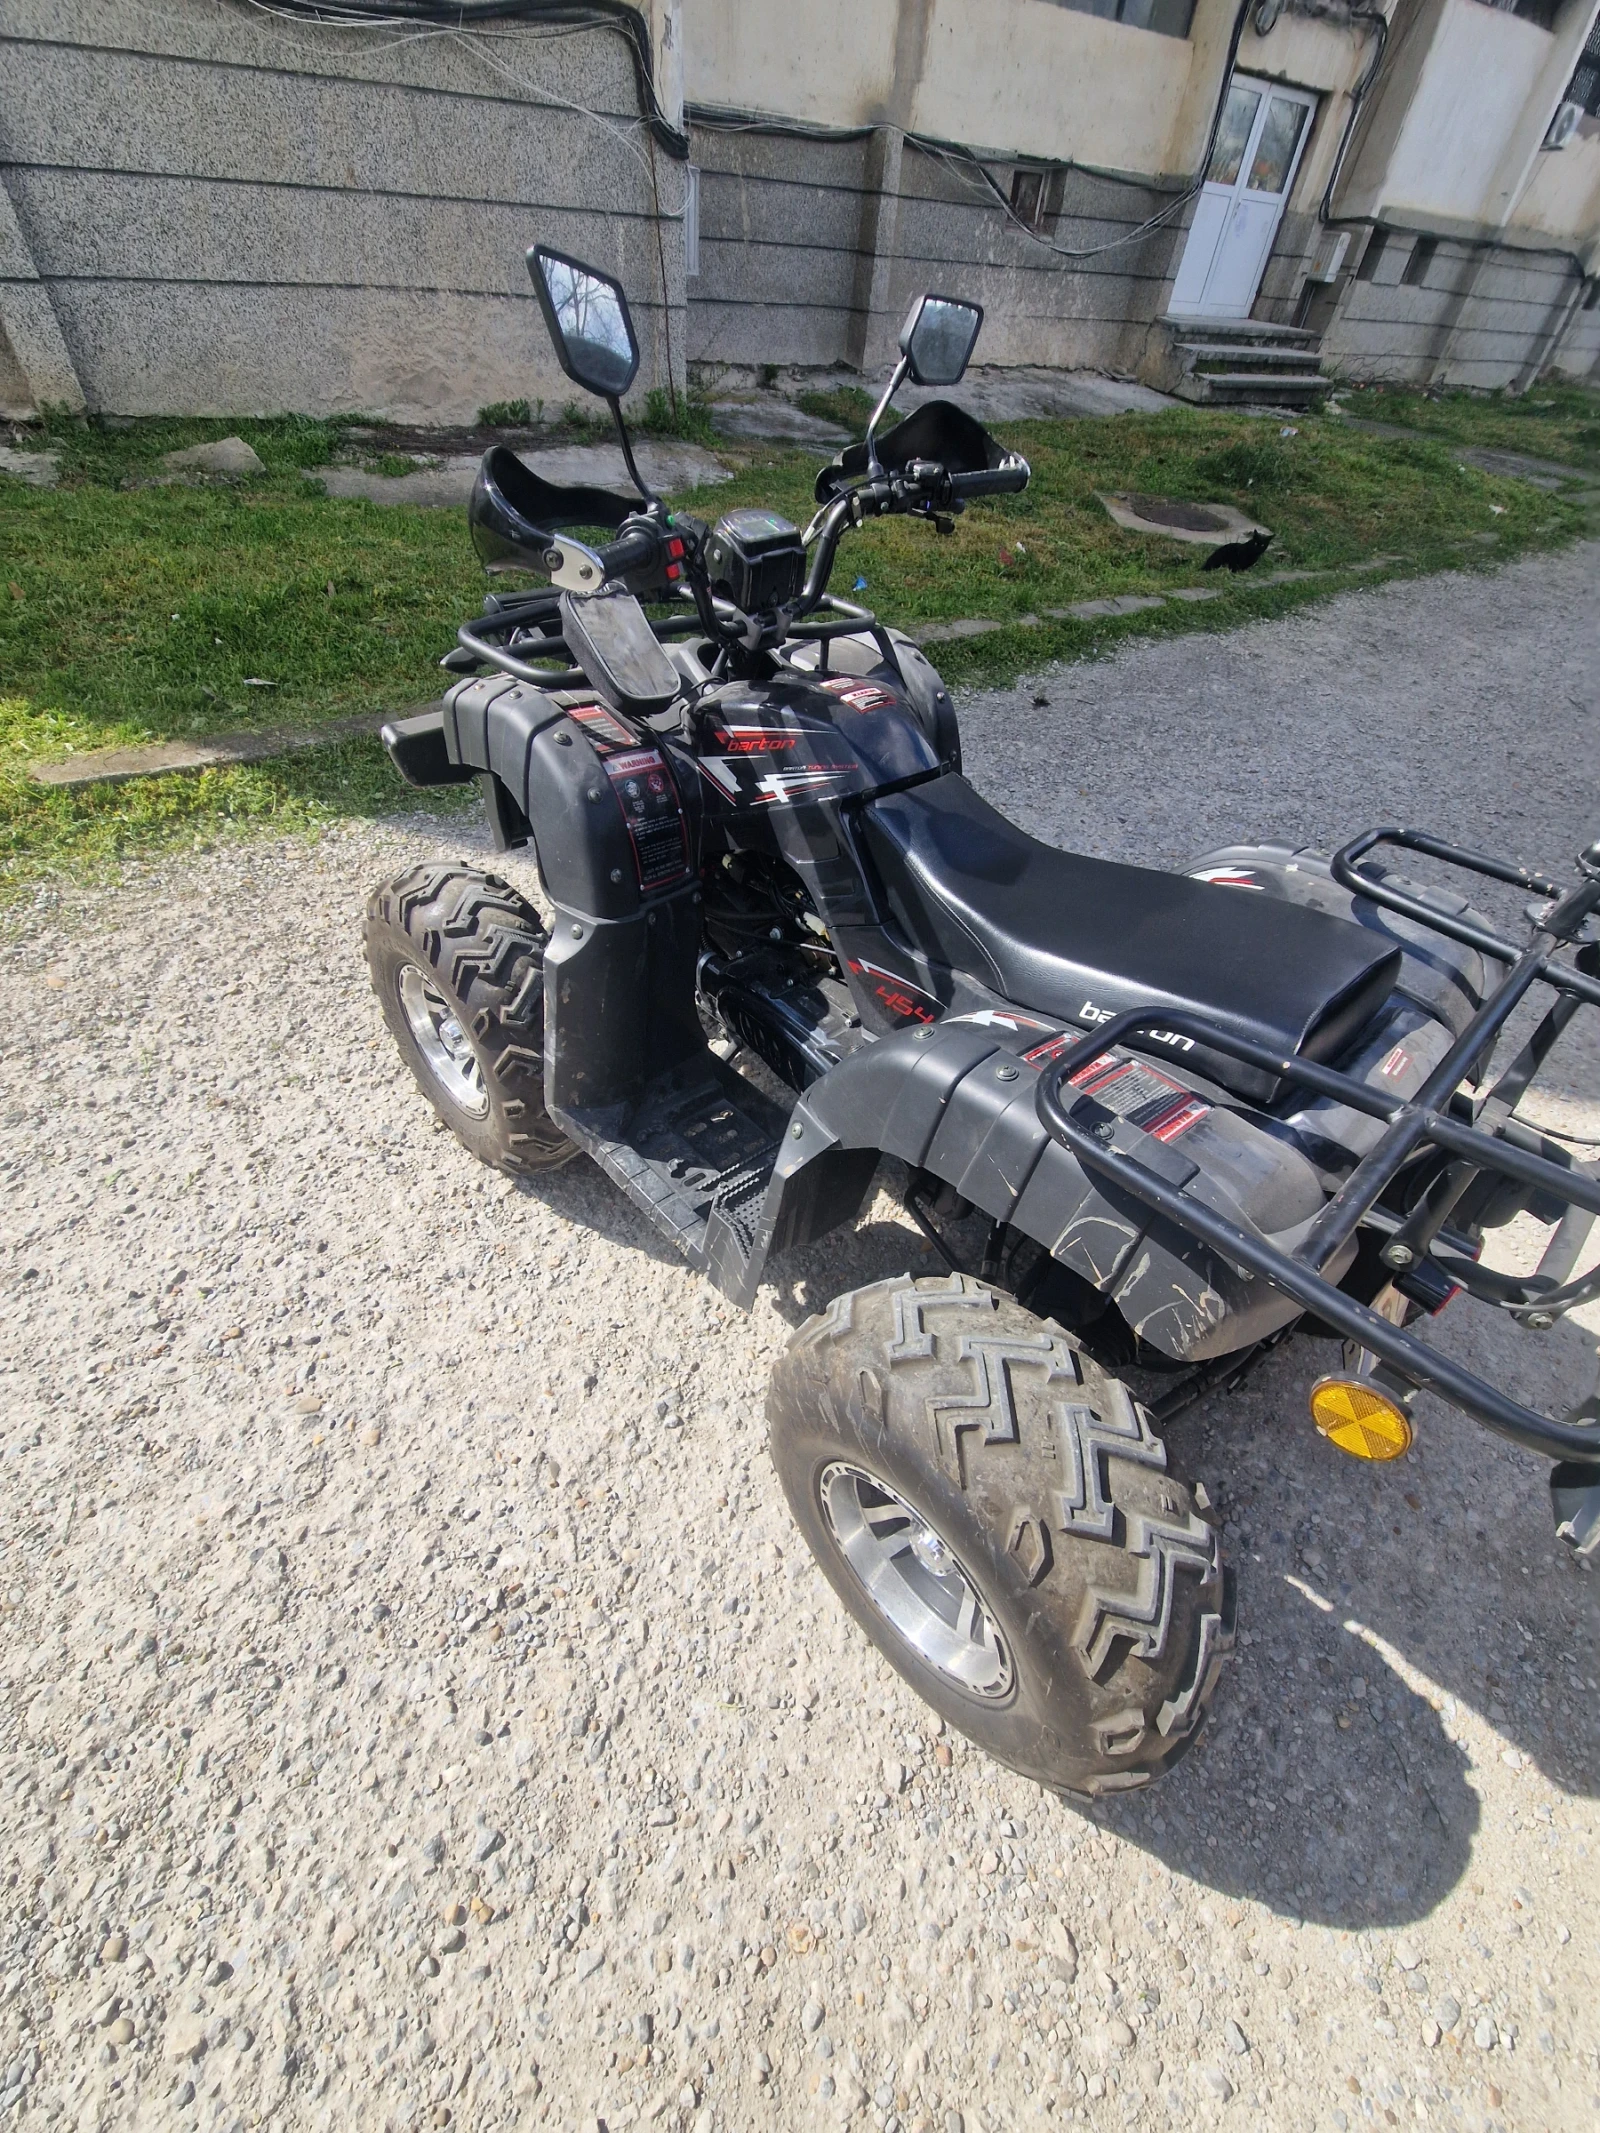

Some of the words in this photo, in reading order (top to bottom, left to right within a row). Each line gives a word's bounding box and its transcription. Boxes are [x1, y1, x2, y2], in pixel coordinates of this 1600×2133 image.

[727, 737, 796, 752] barton
[619, 756, 656, 770] WARNING
[875, 985, 935, 1024] 454
[1079, 1001, 1196, 1051] baon
